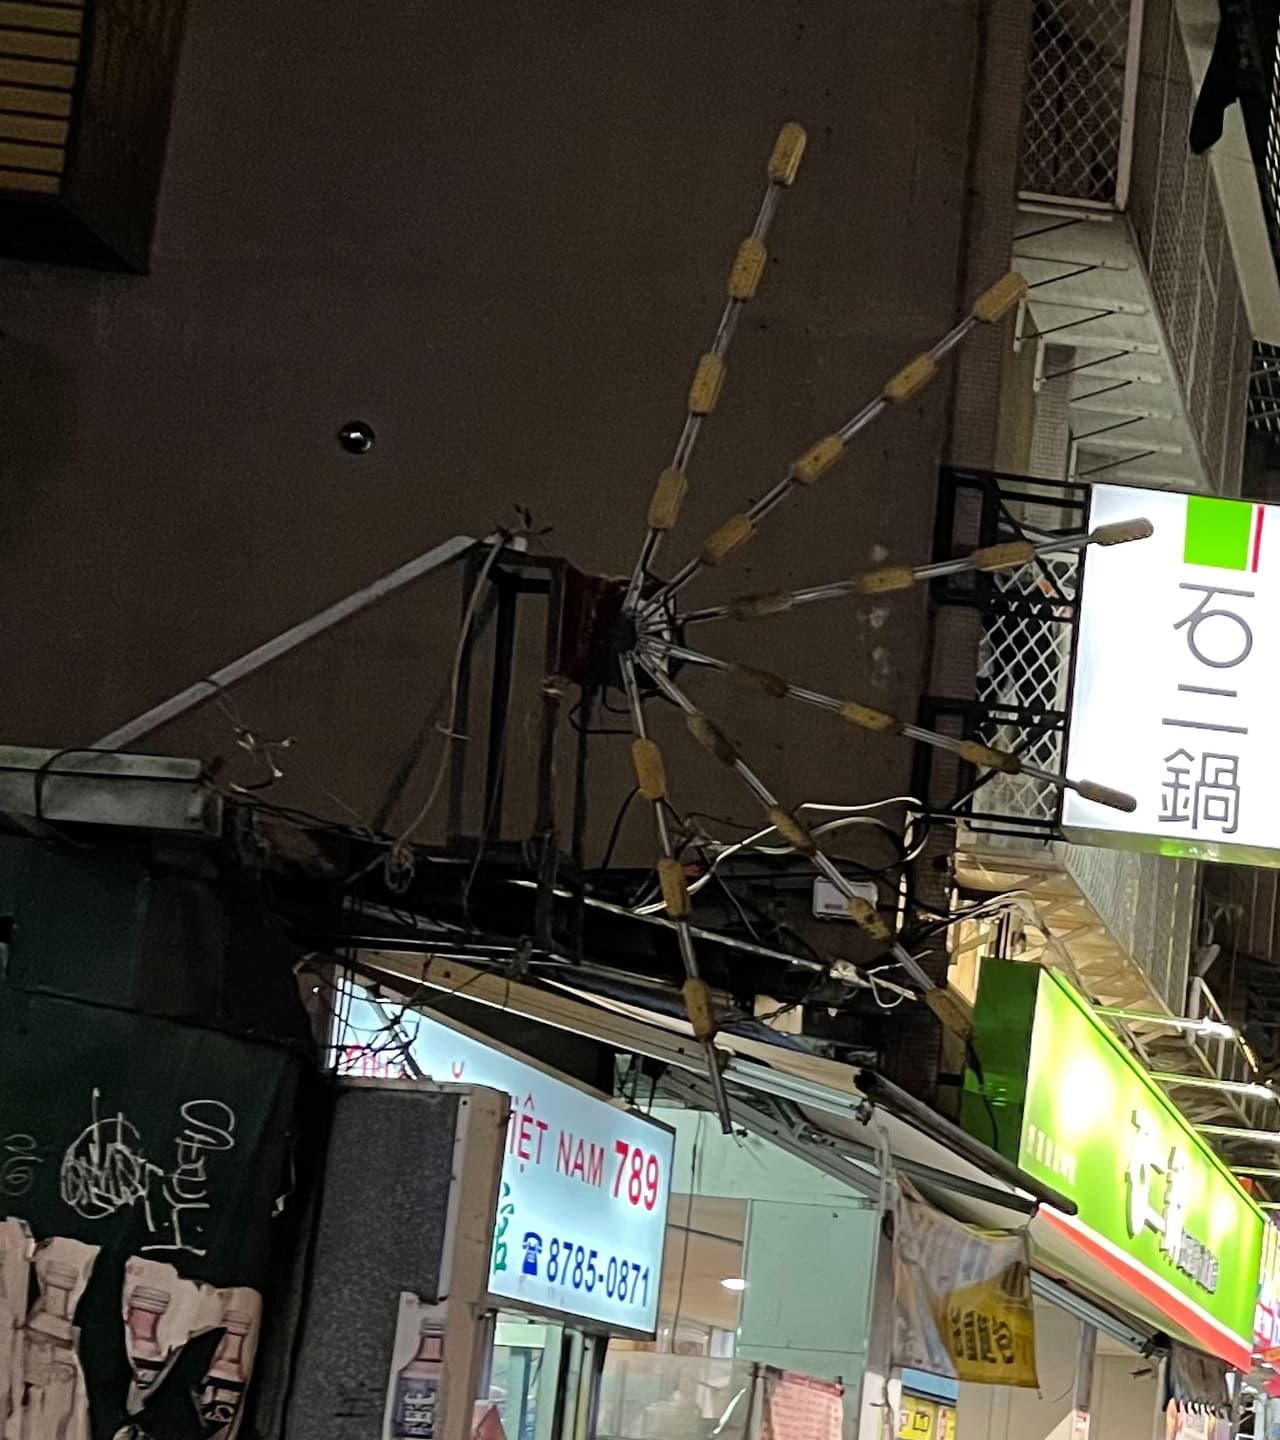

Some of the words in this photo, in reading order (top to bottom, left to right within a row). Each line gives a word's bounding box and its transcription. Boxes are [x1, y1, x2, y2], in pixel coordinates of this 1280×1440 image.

[1158, 582, 1255, 834] 石二鍋
[509, 1093, 549, 1174] IỆT
[557, 1131, 604, 1187] NAM
[612, 1140, 660, 1211] 789
[546, 1238, 650, 1308] 8785-0871
